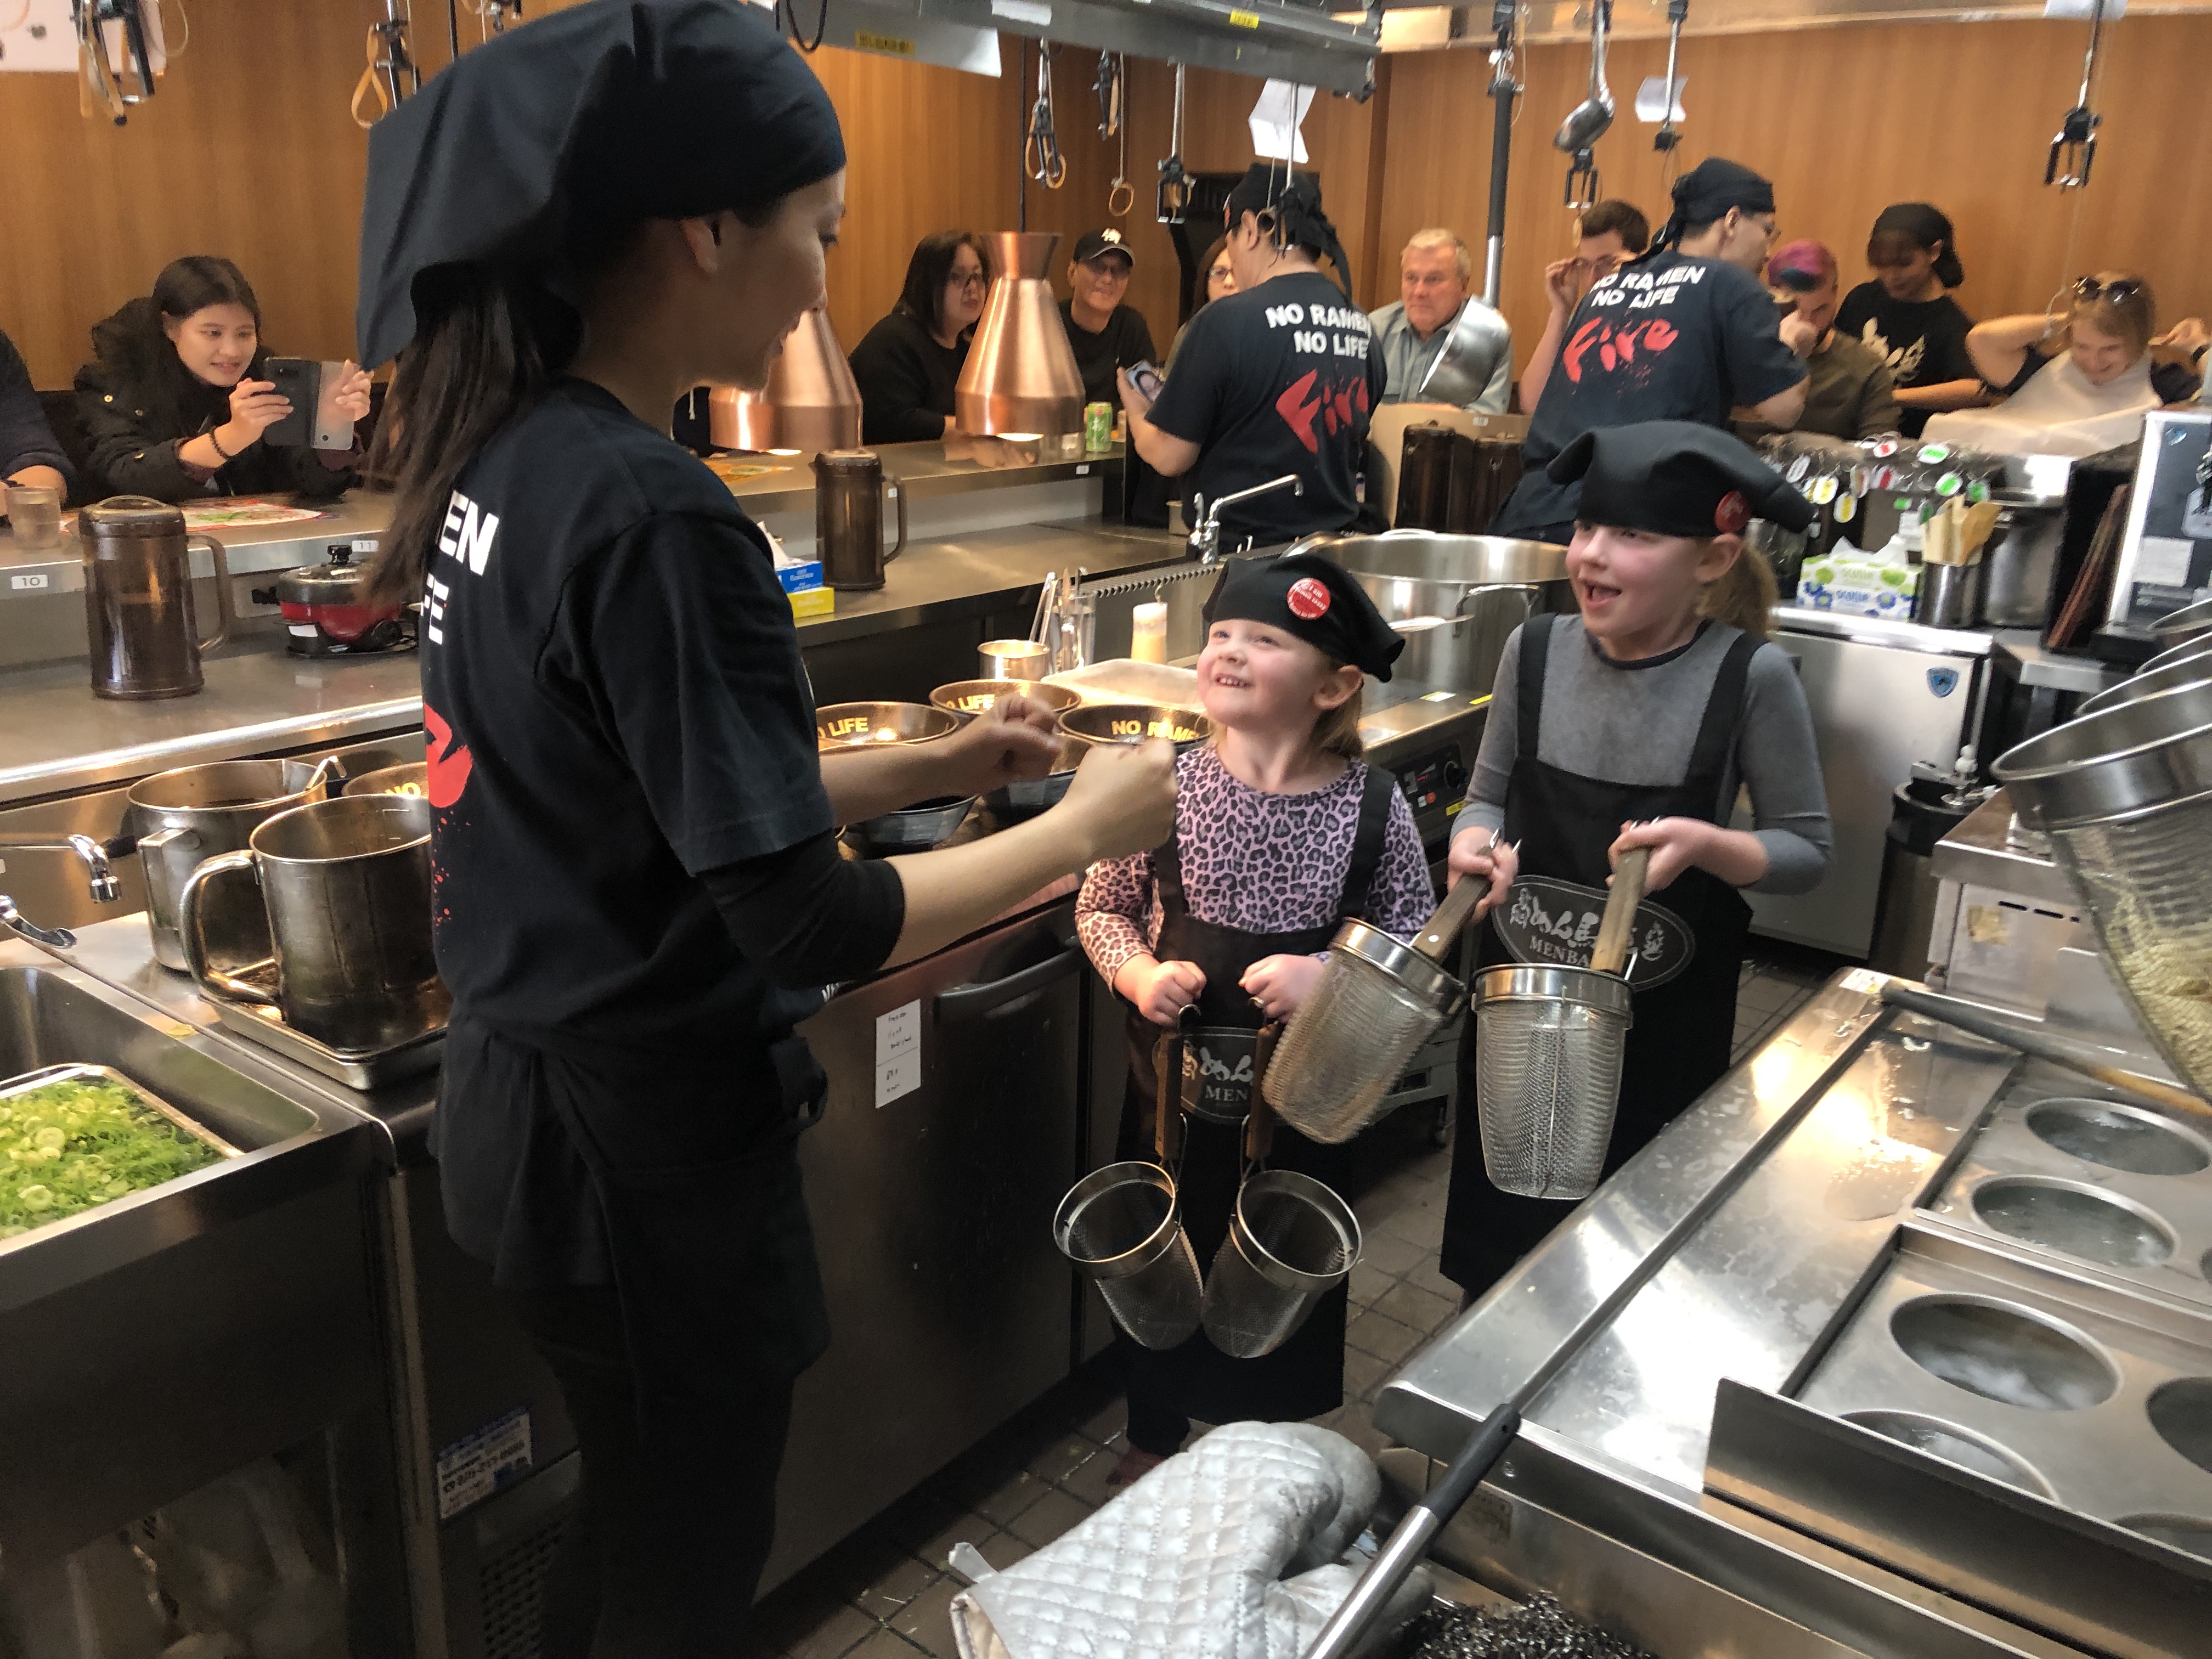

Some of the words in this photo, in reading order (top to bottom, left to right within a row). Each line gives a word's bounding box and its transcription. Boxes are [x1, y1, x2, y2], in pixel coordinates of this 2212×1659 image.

[1619, 265, 1707, 291] RAMEN
[1591, 289, 1626, 307] NO
[1628, 285, 1680, 308] LIFE
[1265, 302, 1305, 329] NO
[1294, 330, 1327, 354] NO
[1333, 332, 1370, 360] LIFE
[436, 489, 499, 576] EN
[360, 542, 371, 550] 11
[22, 577, 40, 586] 10
[957, 694, 995, 710] LIFE
[827, 716, 868, 737] LIFE
[1111, 720, 1142, 735] NO
